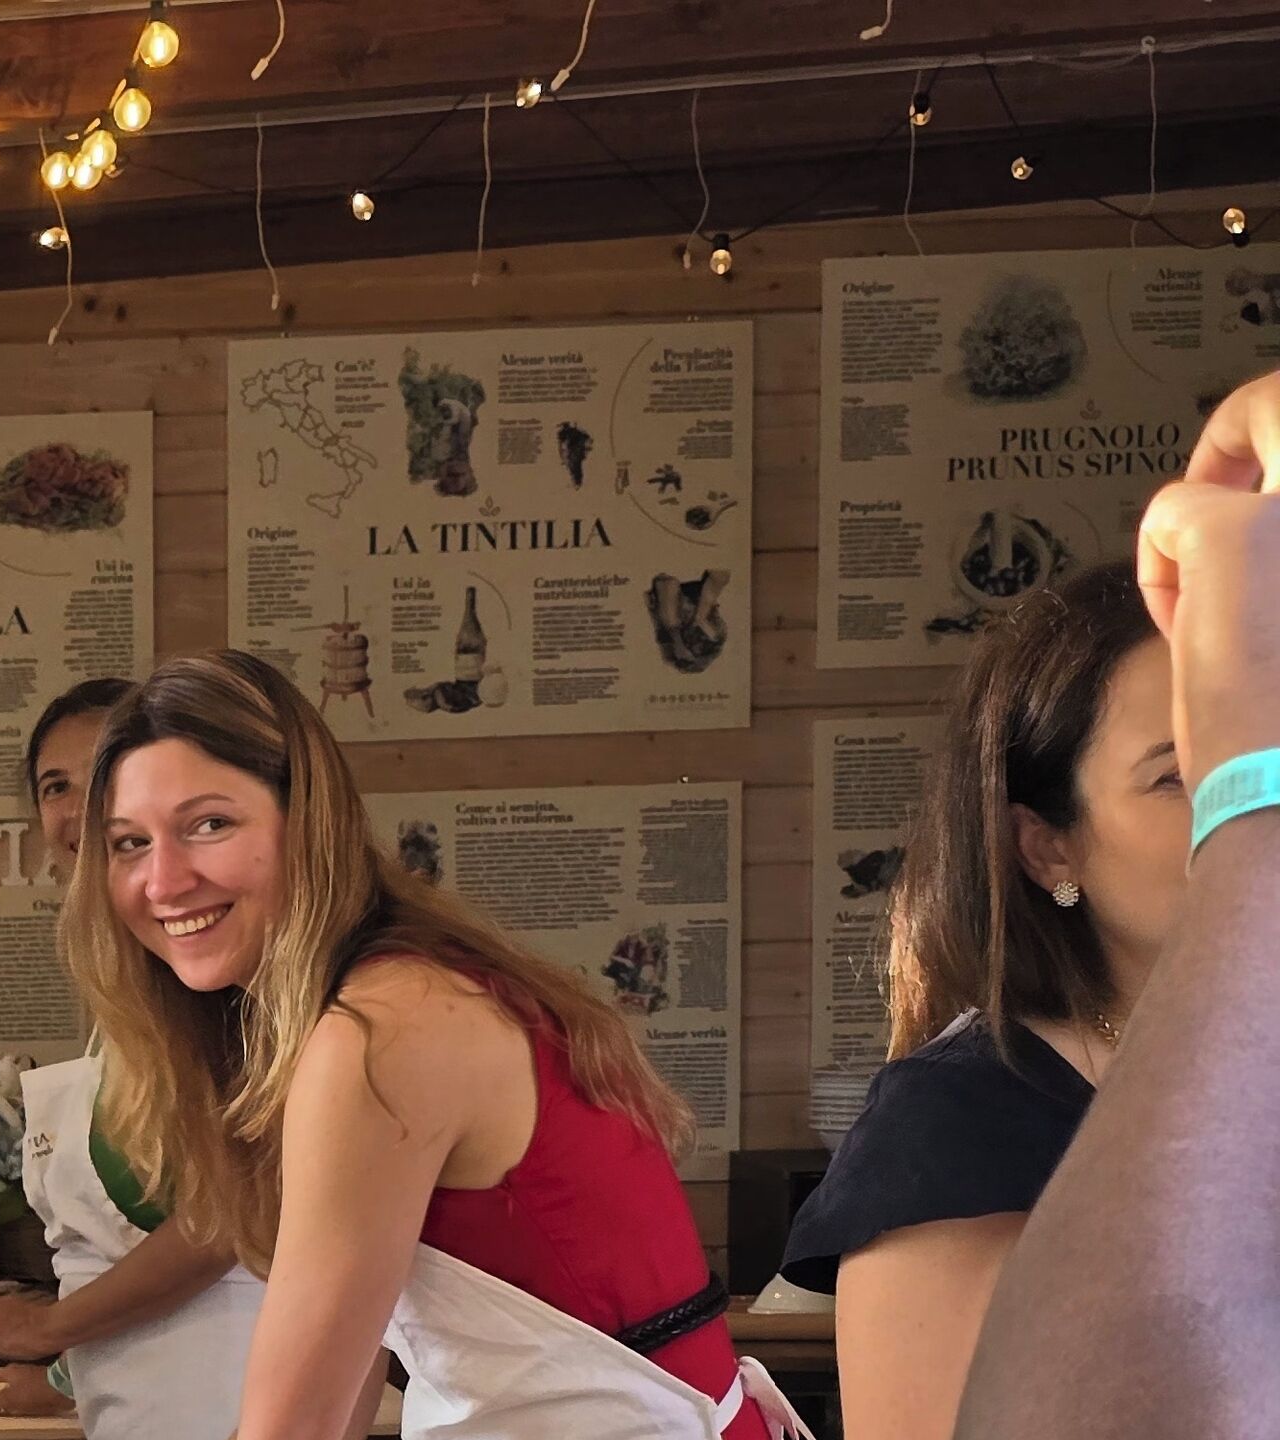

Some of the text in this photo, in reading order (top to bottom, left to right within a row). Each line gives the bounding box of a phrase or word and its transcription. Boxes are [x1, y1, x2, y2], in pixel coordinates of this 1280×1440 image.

[999, 421, 1181, 454] PRUGNOLO
[947, 455, 1076, 483] PRUNUS
[367, 517, 613, 556] LA TINTILIA
